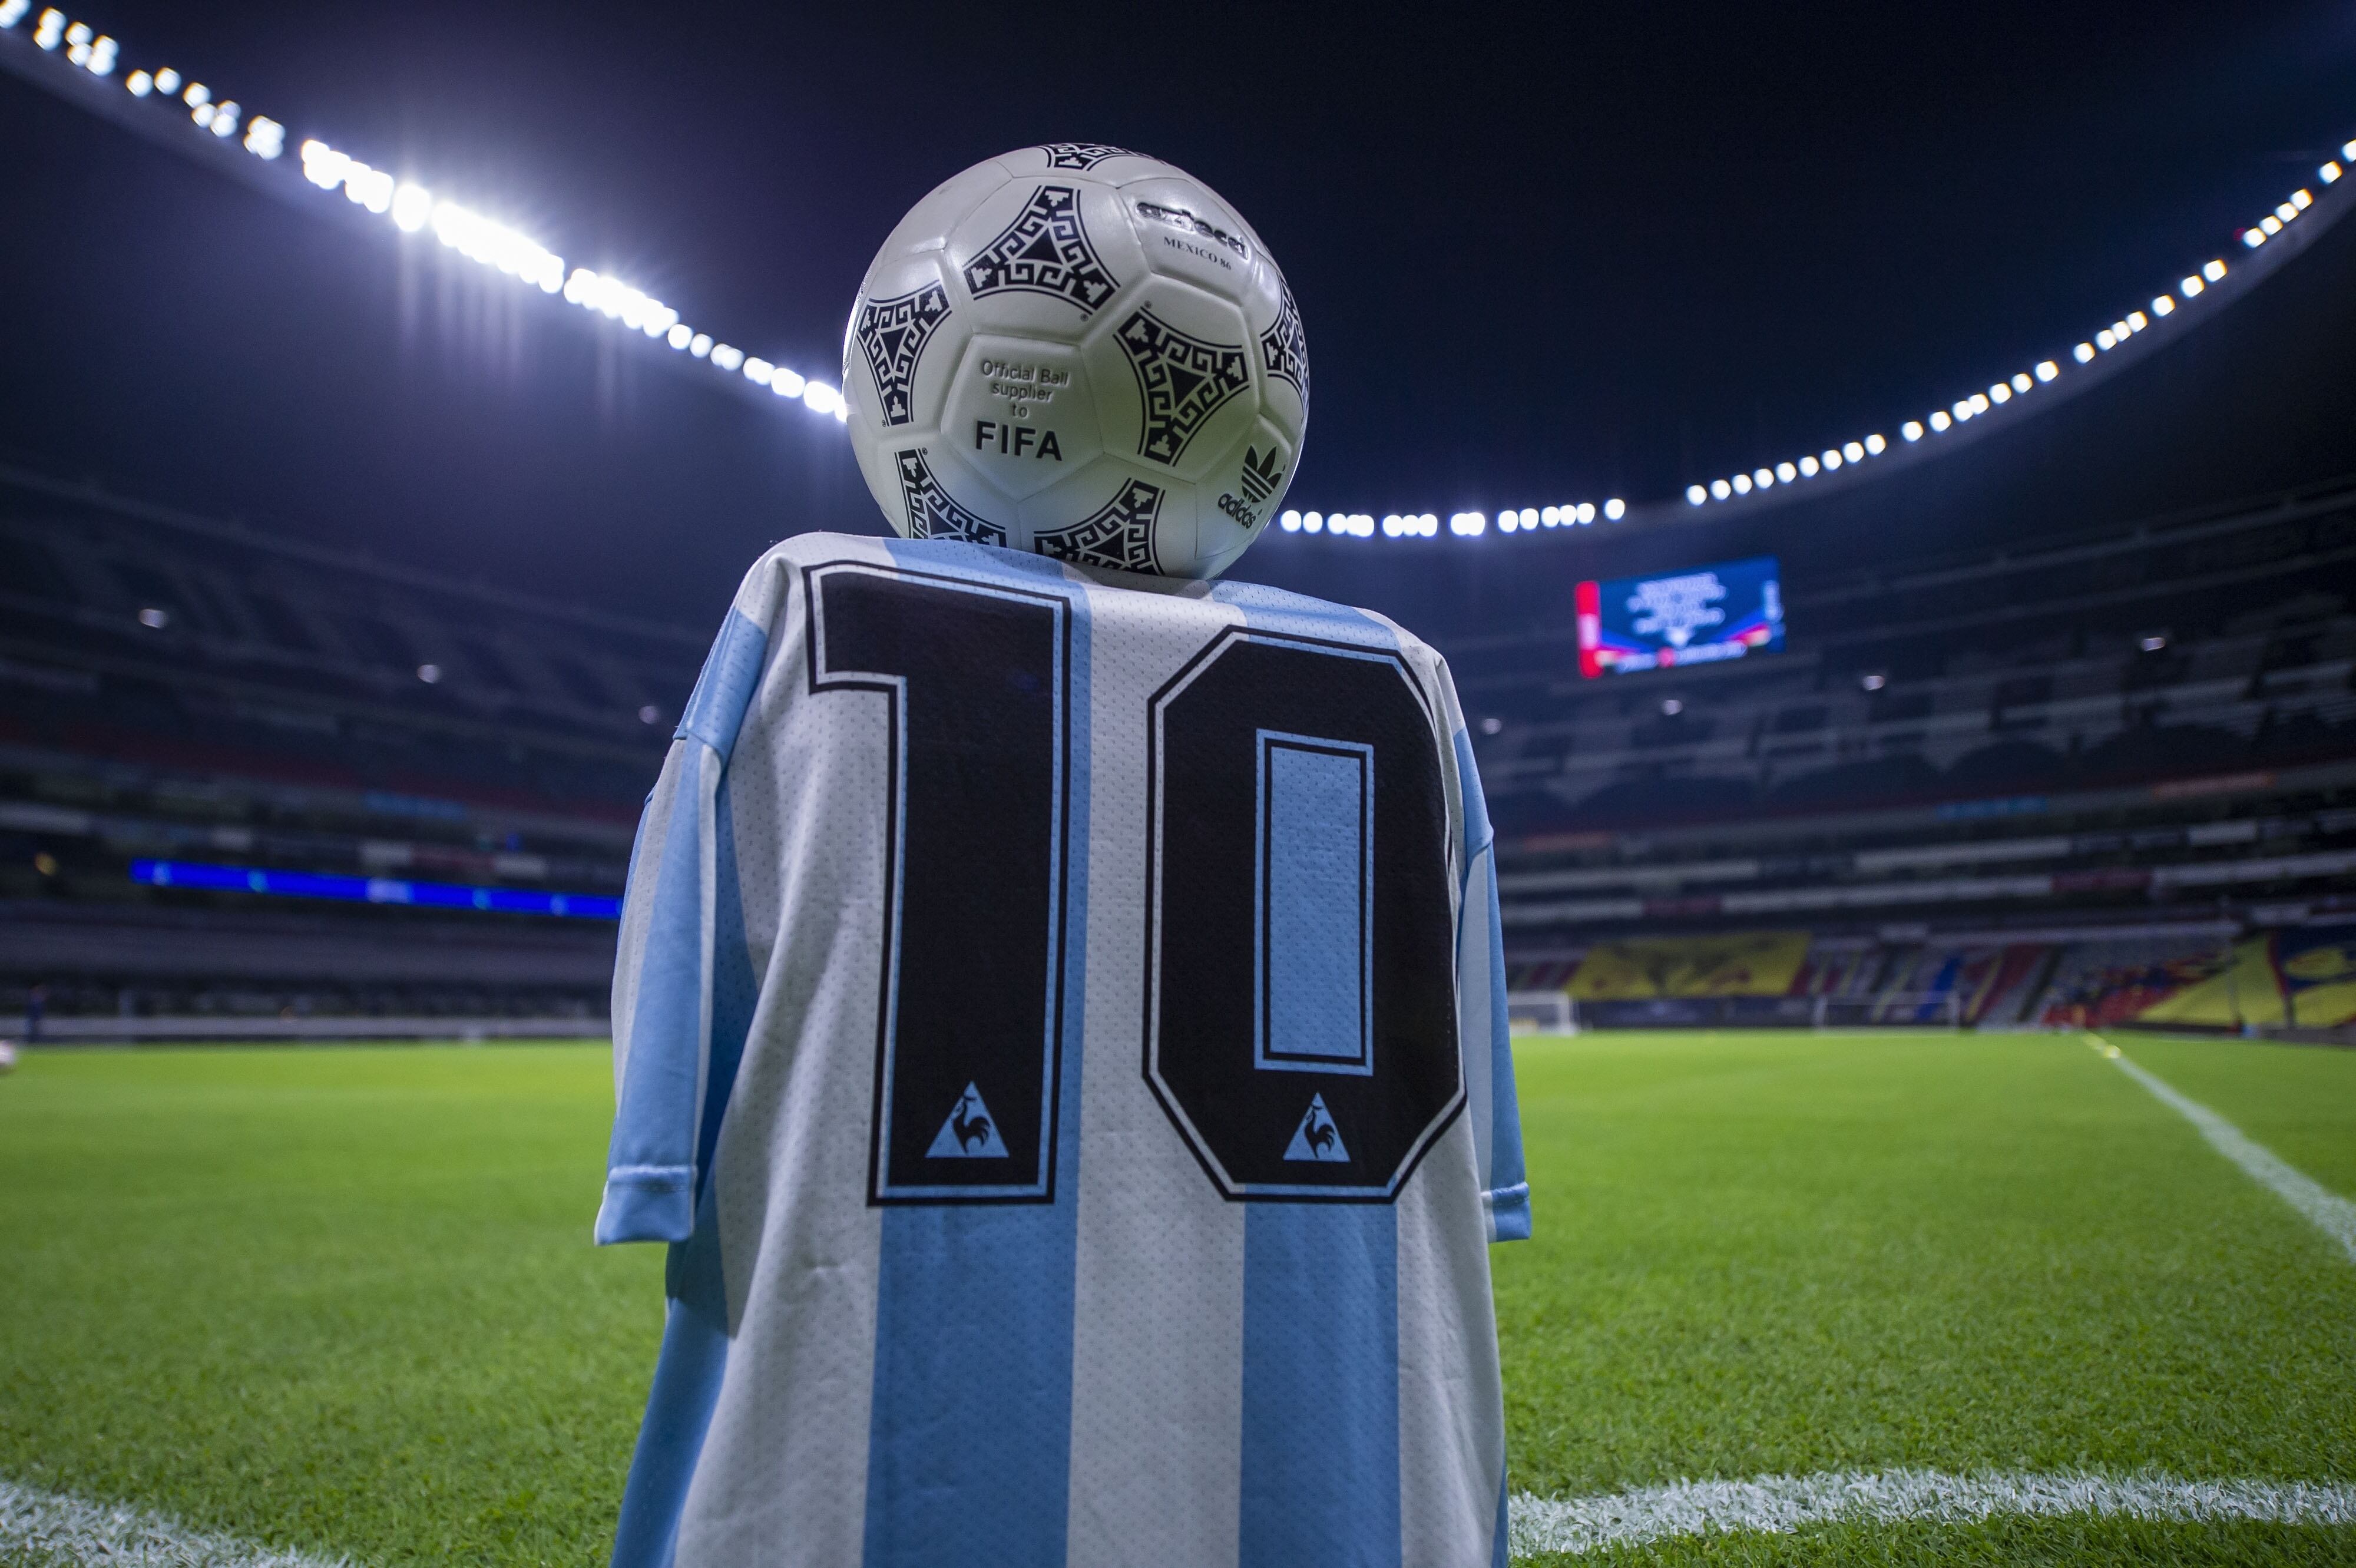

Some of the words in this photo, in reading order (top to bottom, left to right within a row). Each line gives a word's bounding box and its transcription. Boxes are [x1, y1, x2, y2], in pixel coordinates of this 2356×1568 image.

[1163, 236, 1217, 263] MEXICO
[1220, 258, 1232, 271] 86
[981, 359, 1035, 382] Official
[1040, 368, 1069, 386] Ball
[992, 382, 1053, 402] supplier
[1011, 402, 1028, 418] to
[975, 420, 1063, 462] FIFA
[1217, 492, 1256, 529] adidas
[803, 560, 1467, 1207] 10
